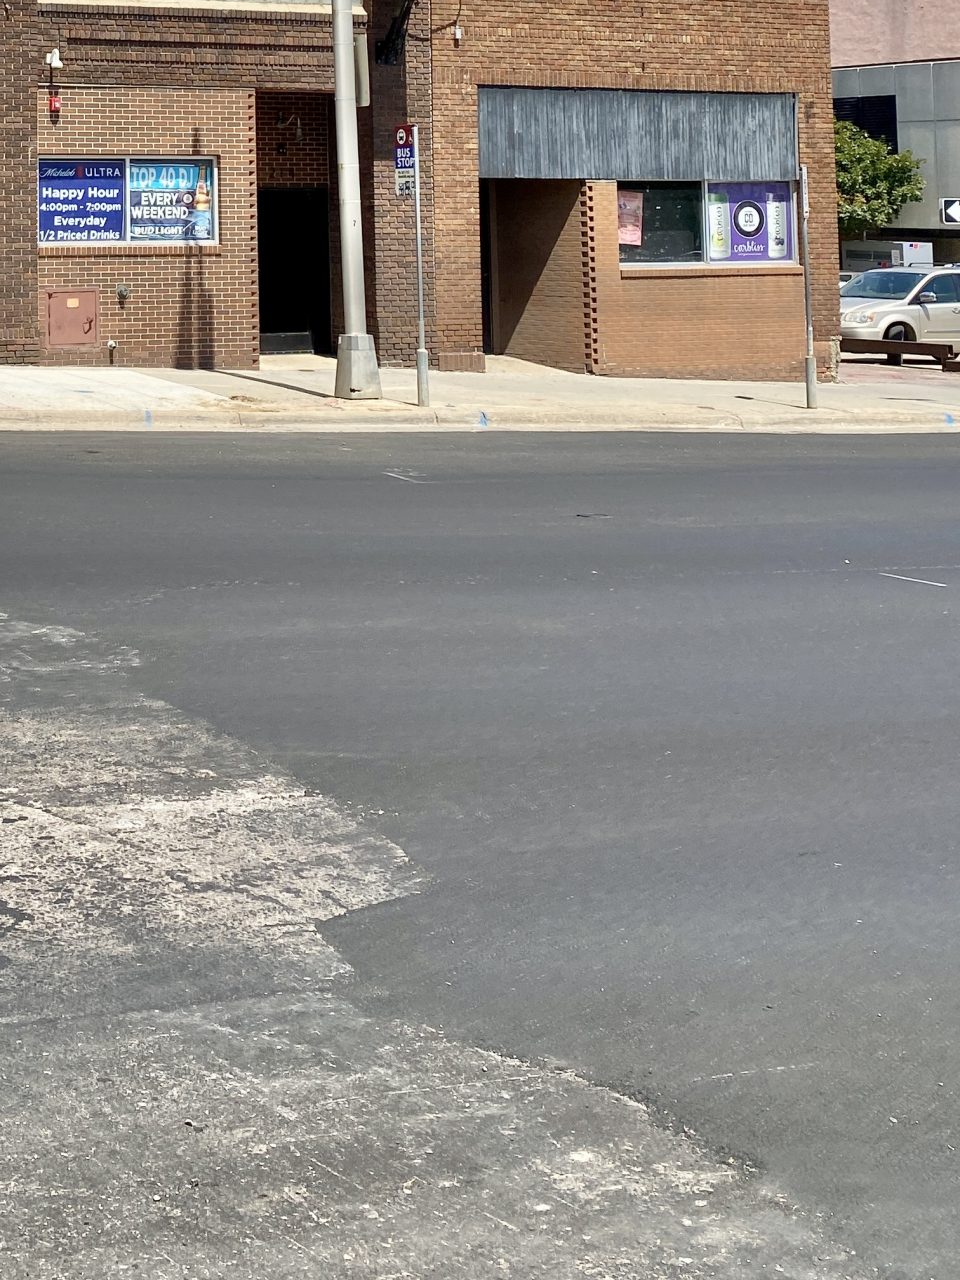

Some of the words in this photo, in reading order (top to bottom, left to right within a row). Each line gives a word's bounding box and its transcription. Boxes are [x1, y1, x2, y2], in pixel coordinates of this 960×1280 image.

[397, 148, 410, 157] BUS
[397, 158, 415, 167] STOP
[40, 168, 76, 177] Michelob
[85, 168, 121, 176] ULTRA
[131, 167, 156, 188] TOP
[160, 167, 176, 188] 40
[178, 168, 194, 188] DJ
[42, 187, 85, 200] Happy
[88, 187, 119, 198] Hour
[141, 193, 179, 205] EVERY
[40, 203, 78, 212] 4:00pm
[86, 203, 122, 212] 7:00pm
[131, 207, 189, 219] WEEKEND
[54, 216, 107, 227] Everyday
[40, 230, 55, 242] 1/2
[58, 230, 88, 240] Priced
[90, 230, 120, 240] Drinks
[135, 227, 155, 235] BUD
[156, 227, 184, 235] LIGHT
[734, 241, 766, 253] carbliss
